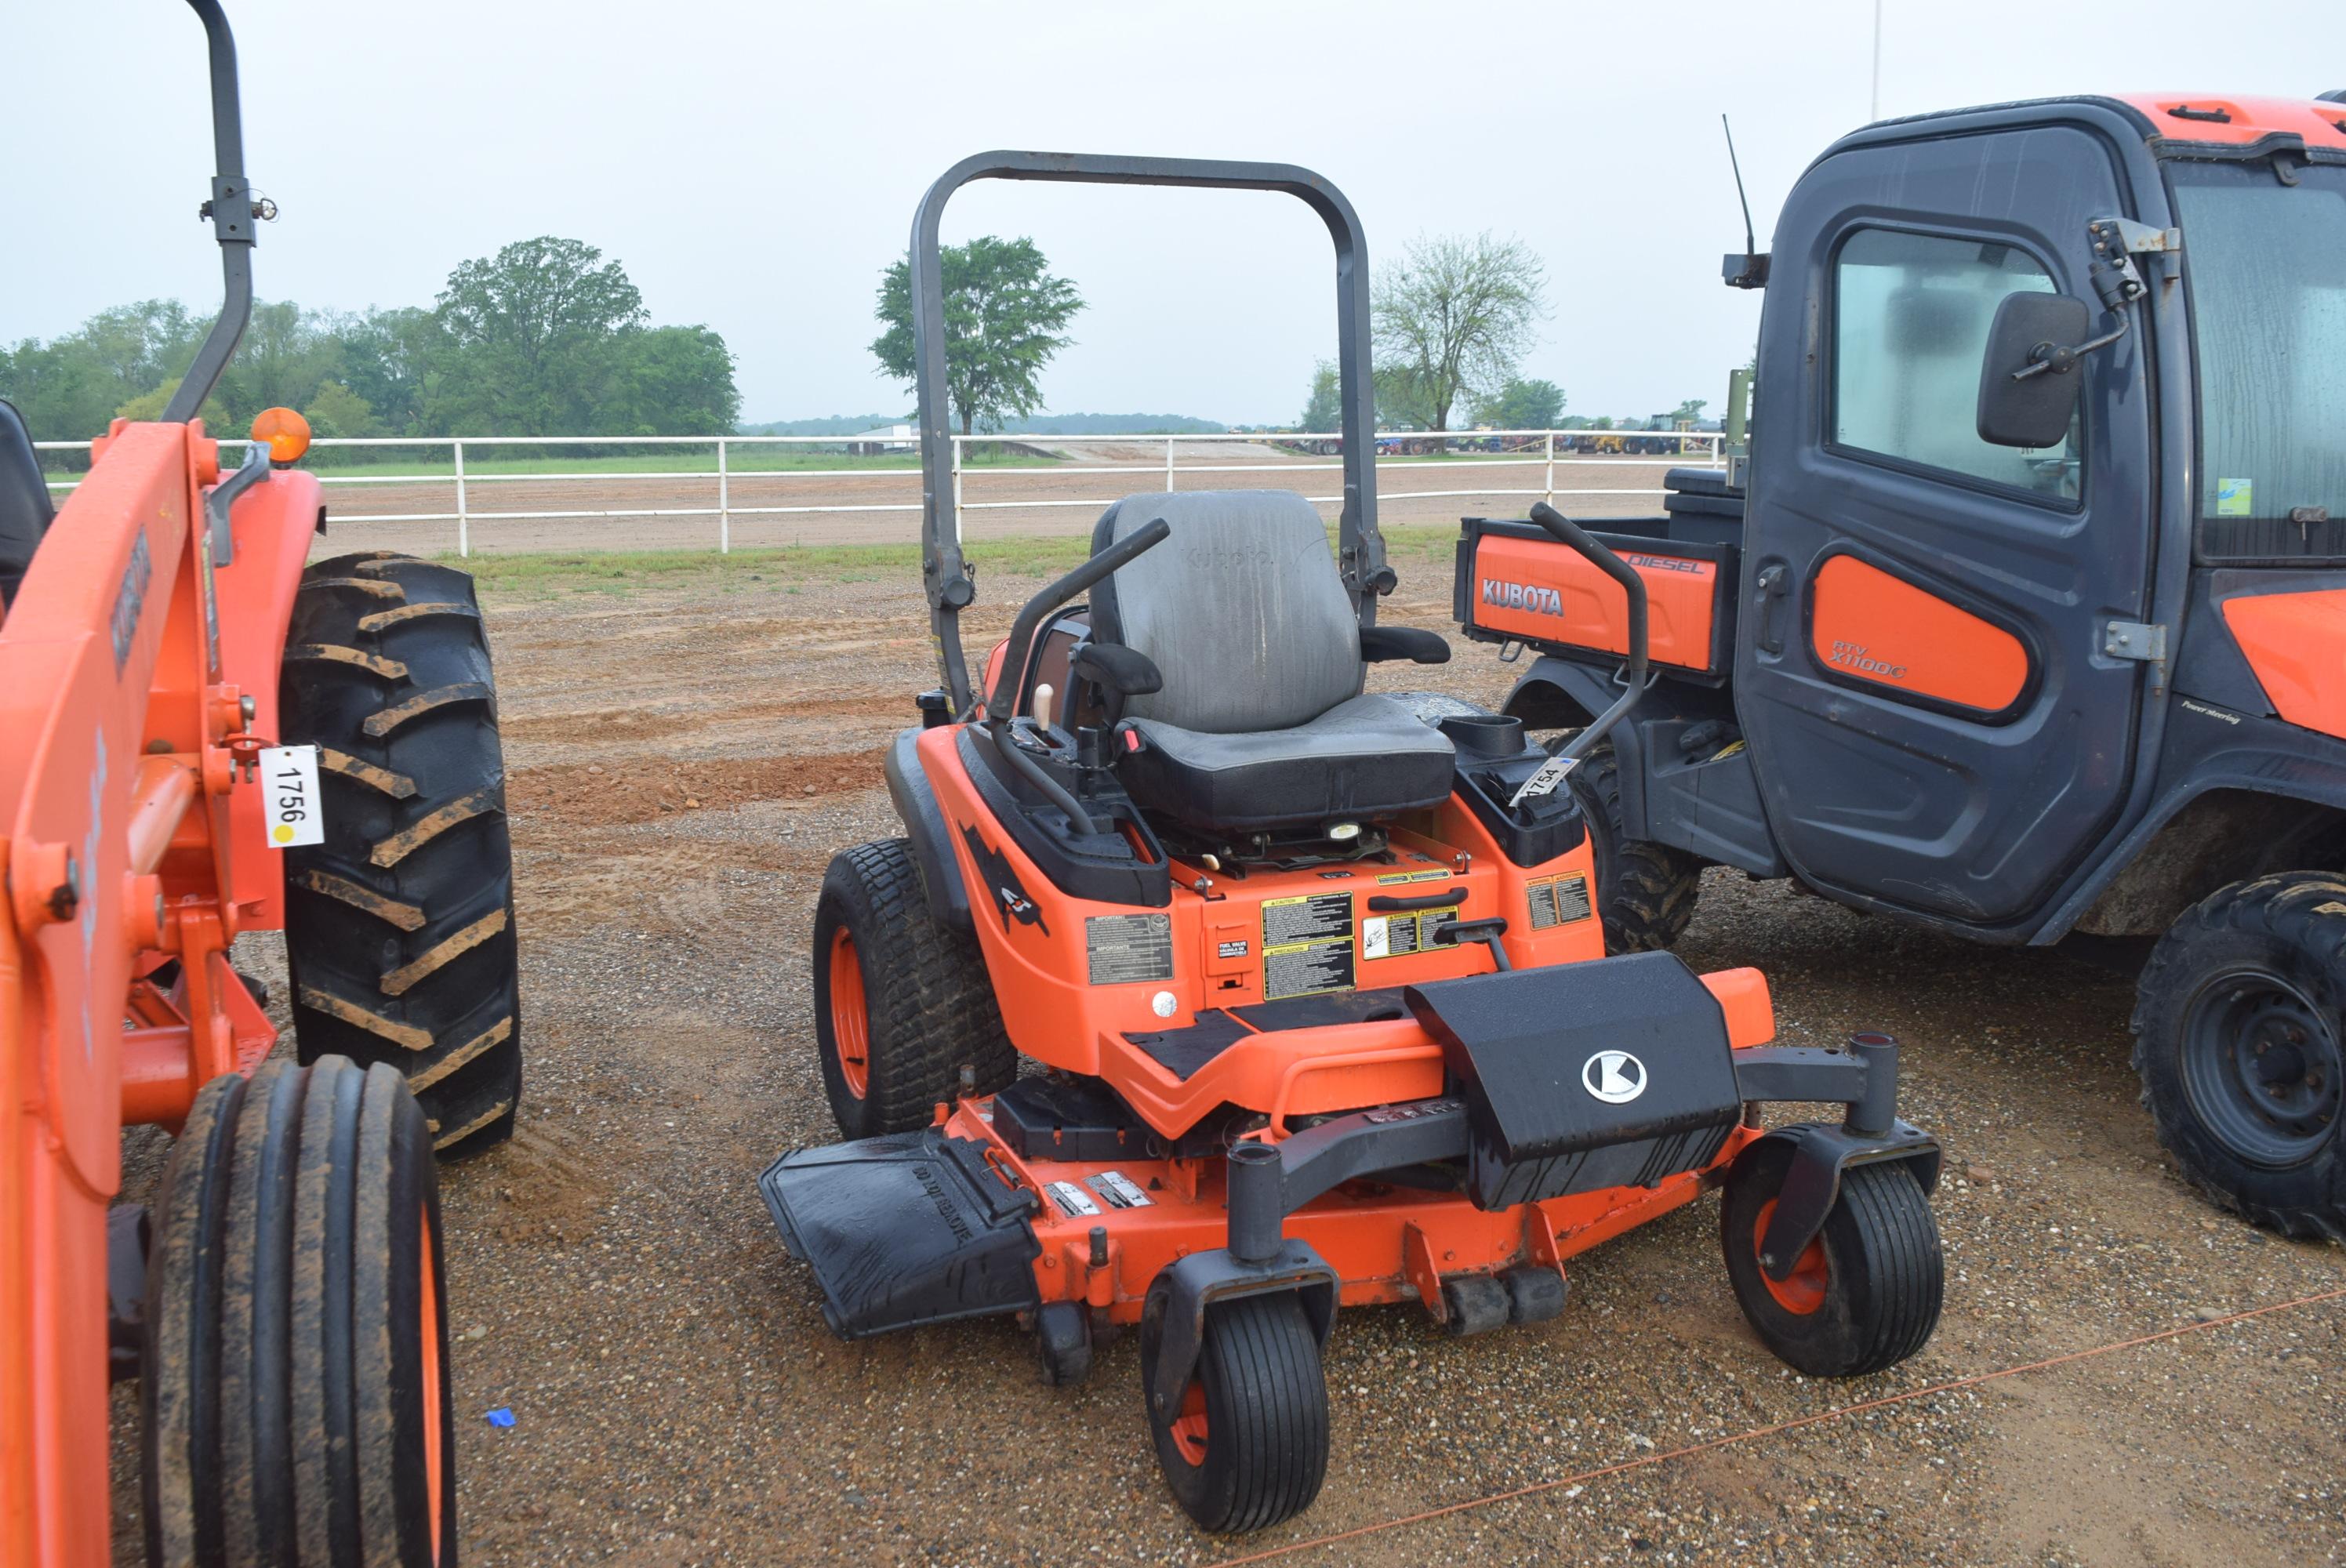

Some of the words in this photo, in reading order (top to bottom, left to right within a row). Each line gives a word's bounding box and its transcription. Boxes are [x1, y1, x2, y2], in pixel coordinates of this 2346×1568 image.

[1627, 554, 1705, 575] DIESEL
[1482, 579, 1564, 618] KUBOTA
[1832, 639, 1868, 655] RTV
[1829, 650, 1908, 678] X1100C
[2181, 700, 2206, 713] Power
[2206, 710, 2241, 725] steering
[276, 768, 306, 822] 1756
